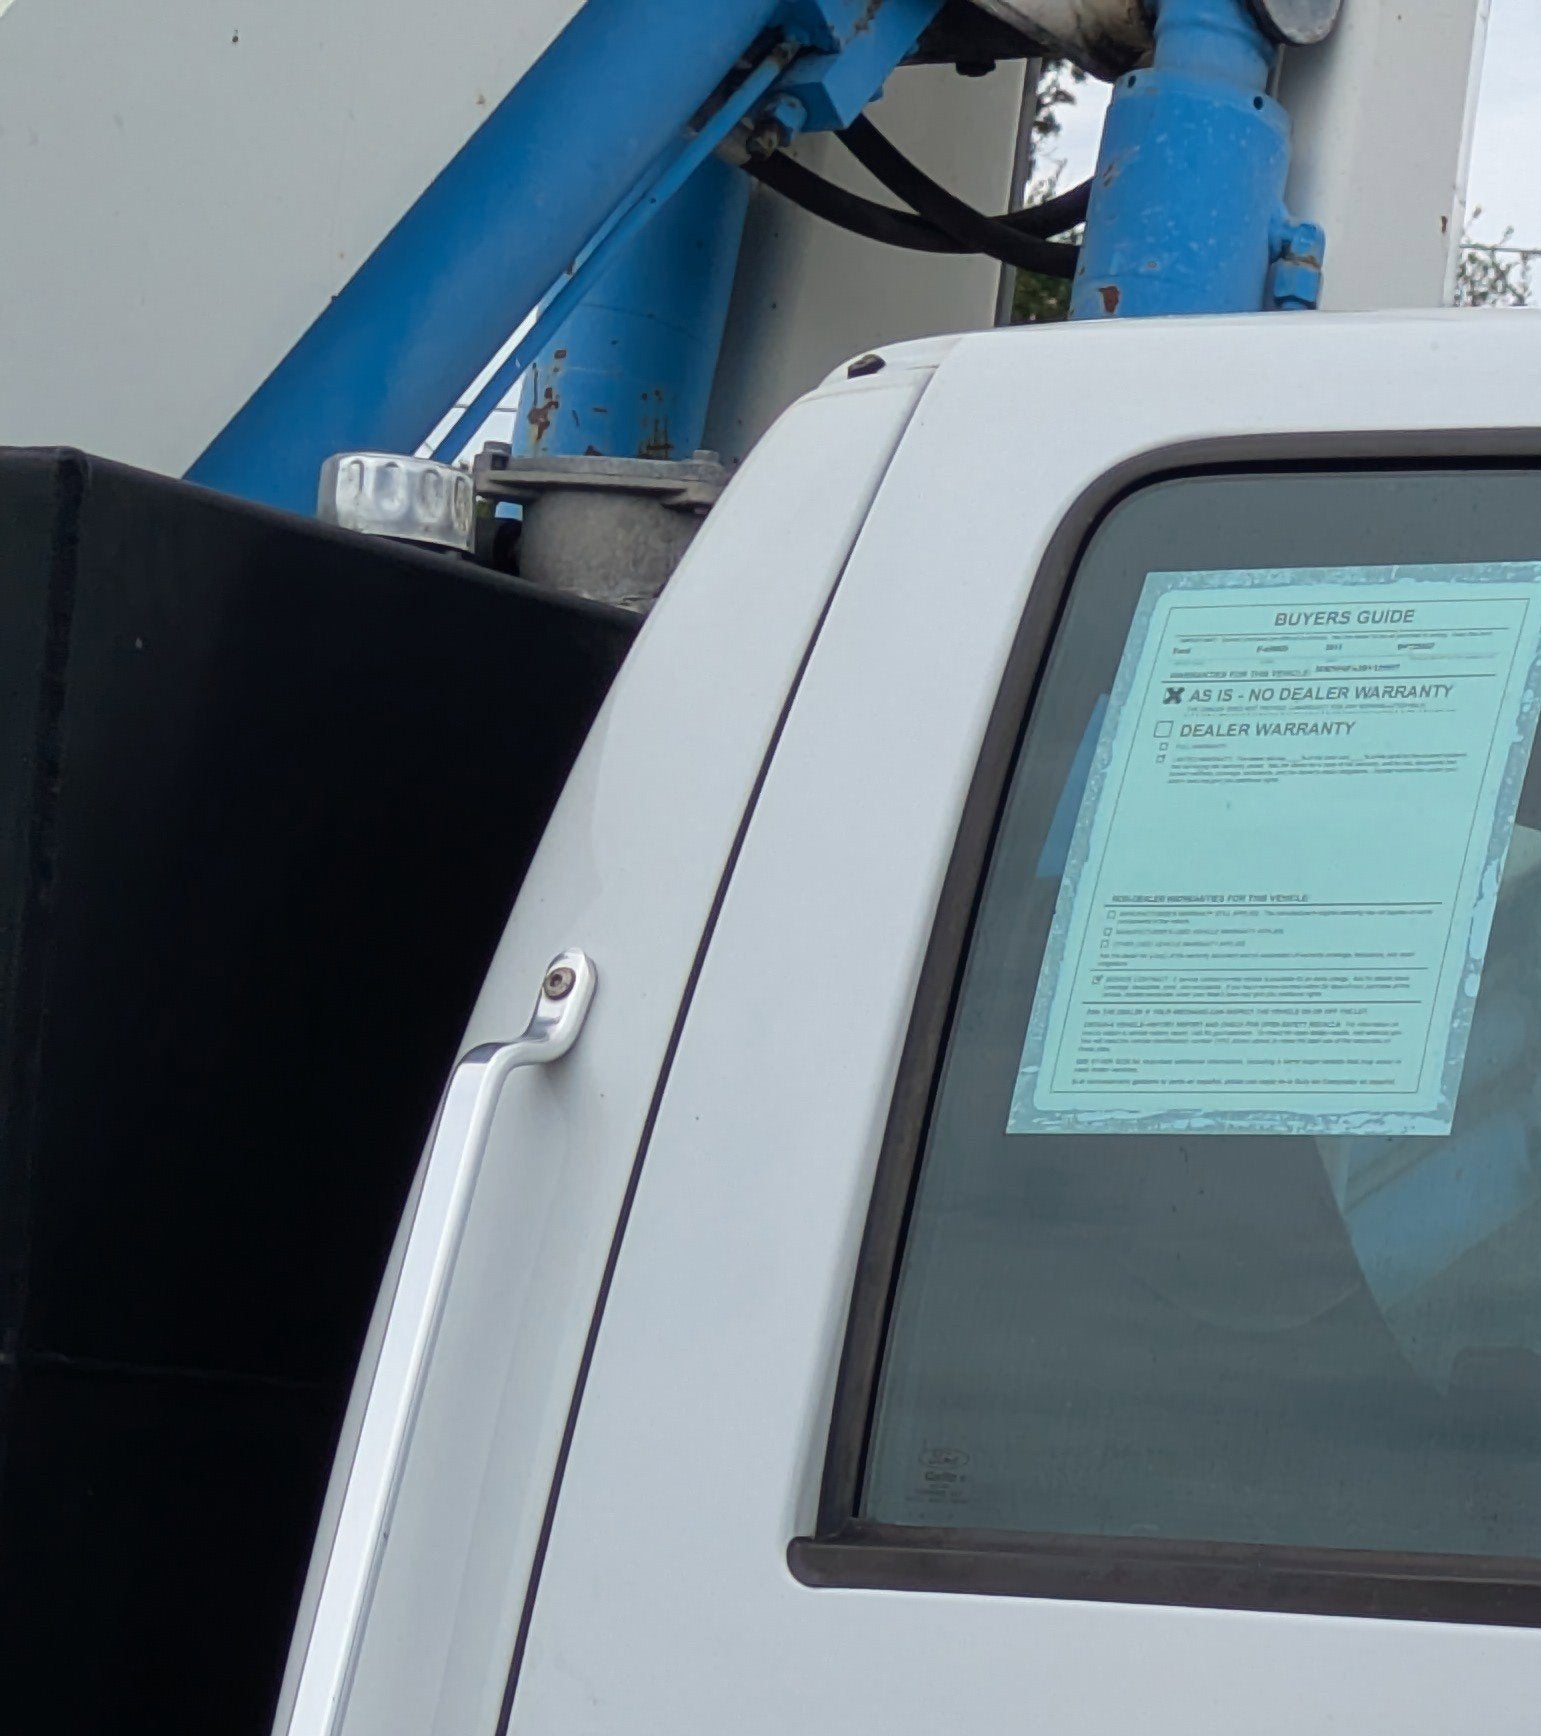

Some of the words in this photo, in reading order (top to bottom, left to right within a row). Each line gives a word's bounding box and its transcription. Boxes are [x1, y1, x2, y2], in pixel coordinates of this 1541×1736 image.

[1274, 610, 1351, 627] BUYERS
[1356, 608, 1416, 625] GUIDE
[1189, 688, 1213, 702] AS
[1217, 688, 1234, 702] IS
[1248, 687, 1275, 702] NO
[1278, 685, 1350, 701] DEALER
[1355, 684, 1454, 700] WARRANTY
[1179, 723, 1251, 738] DEALER
[1255, 721, 1356, 737] WARRANTY
